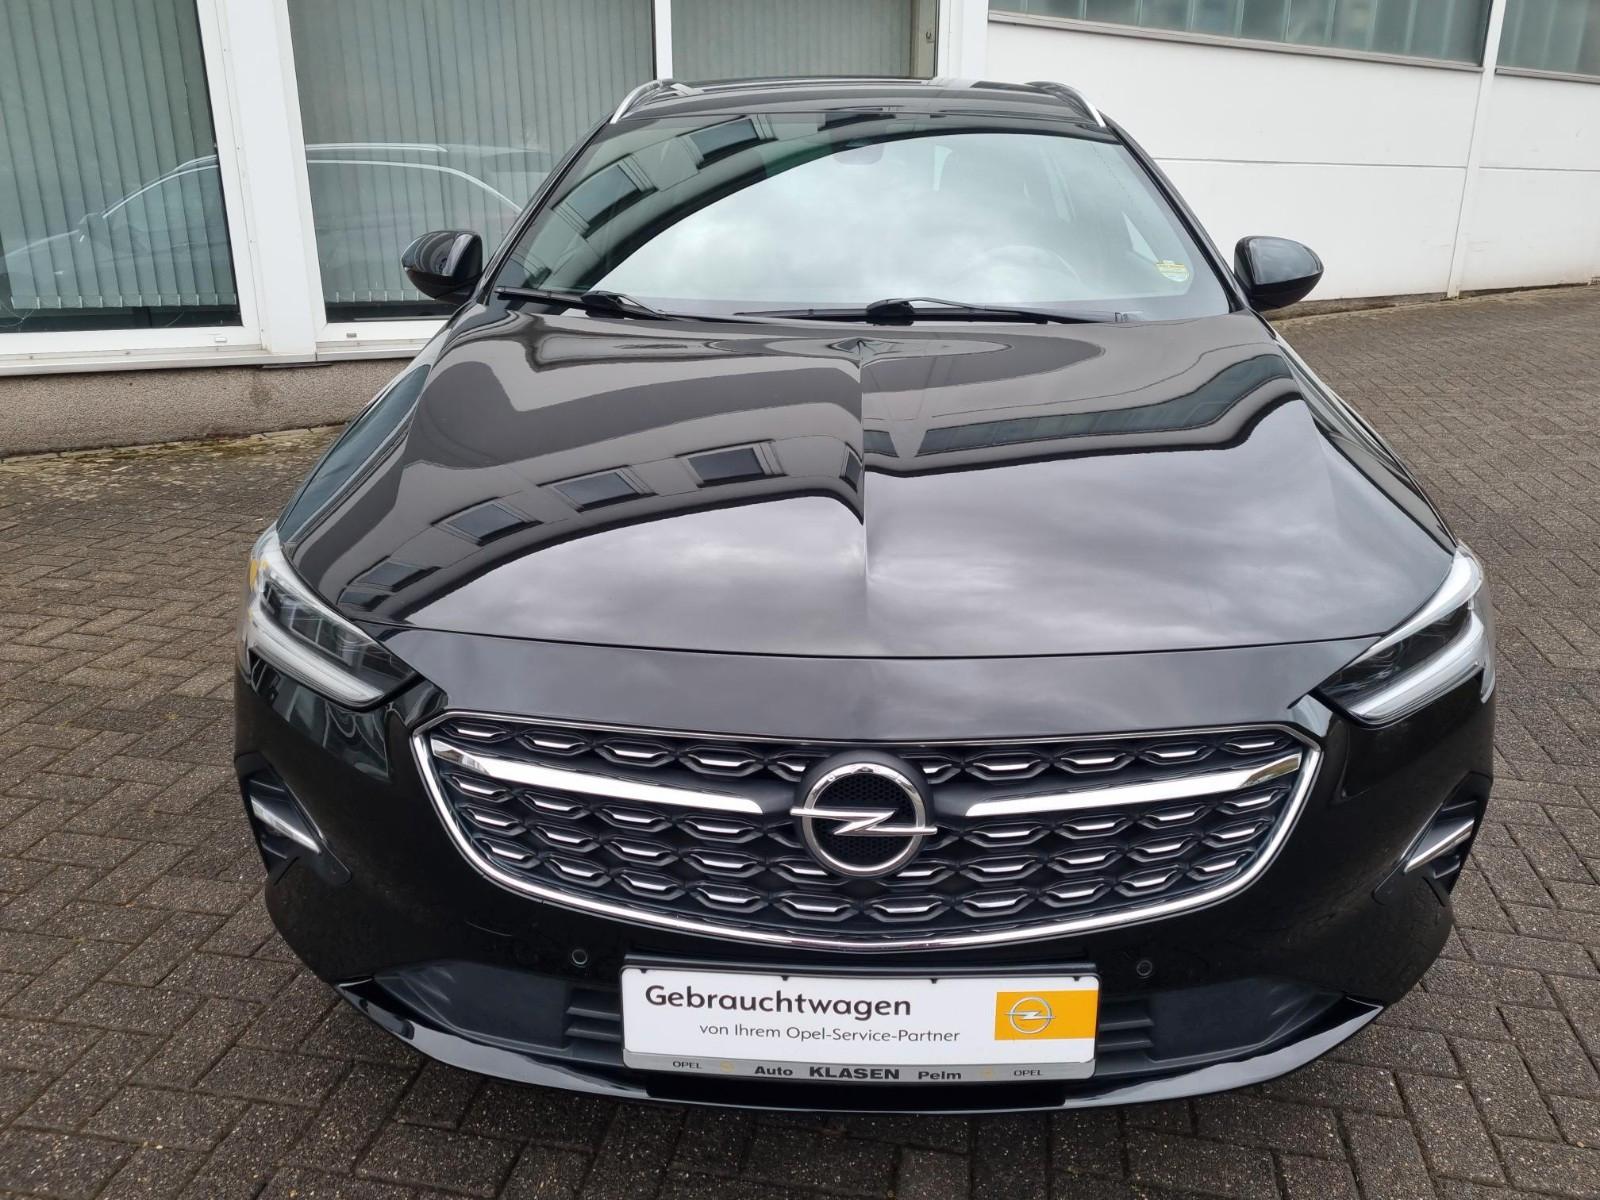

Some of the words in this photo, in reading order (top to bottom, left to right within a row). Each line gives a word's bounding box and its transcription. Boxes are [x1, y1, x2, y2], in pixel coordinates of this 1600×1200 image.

[645, 984, 911, 1021] Gebrauchtwagen
[700, 1024, 729, 1036] von
[735, 1024, 781, 1039] Ihrem
[786, 1026, 960, 1043] Opel-Service-Partner
[672, 1060, 702, 1070] OPEL
[754, 1066, 793, 1077] Auto
[809, 1066, 900, 1080] KLASEN
[918, 1071, 962, 1081] Pelm
[1013, 1069, 1043, 1077] OPEL
